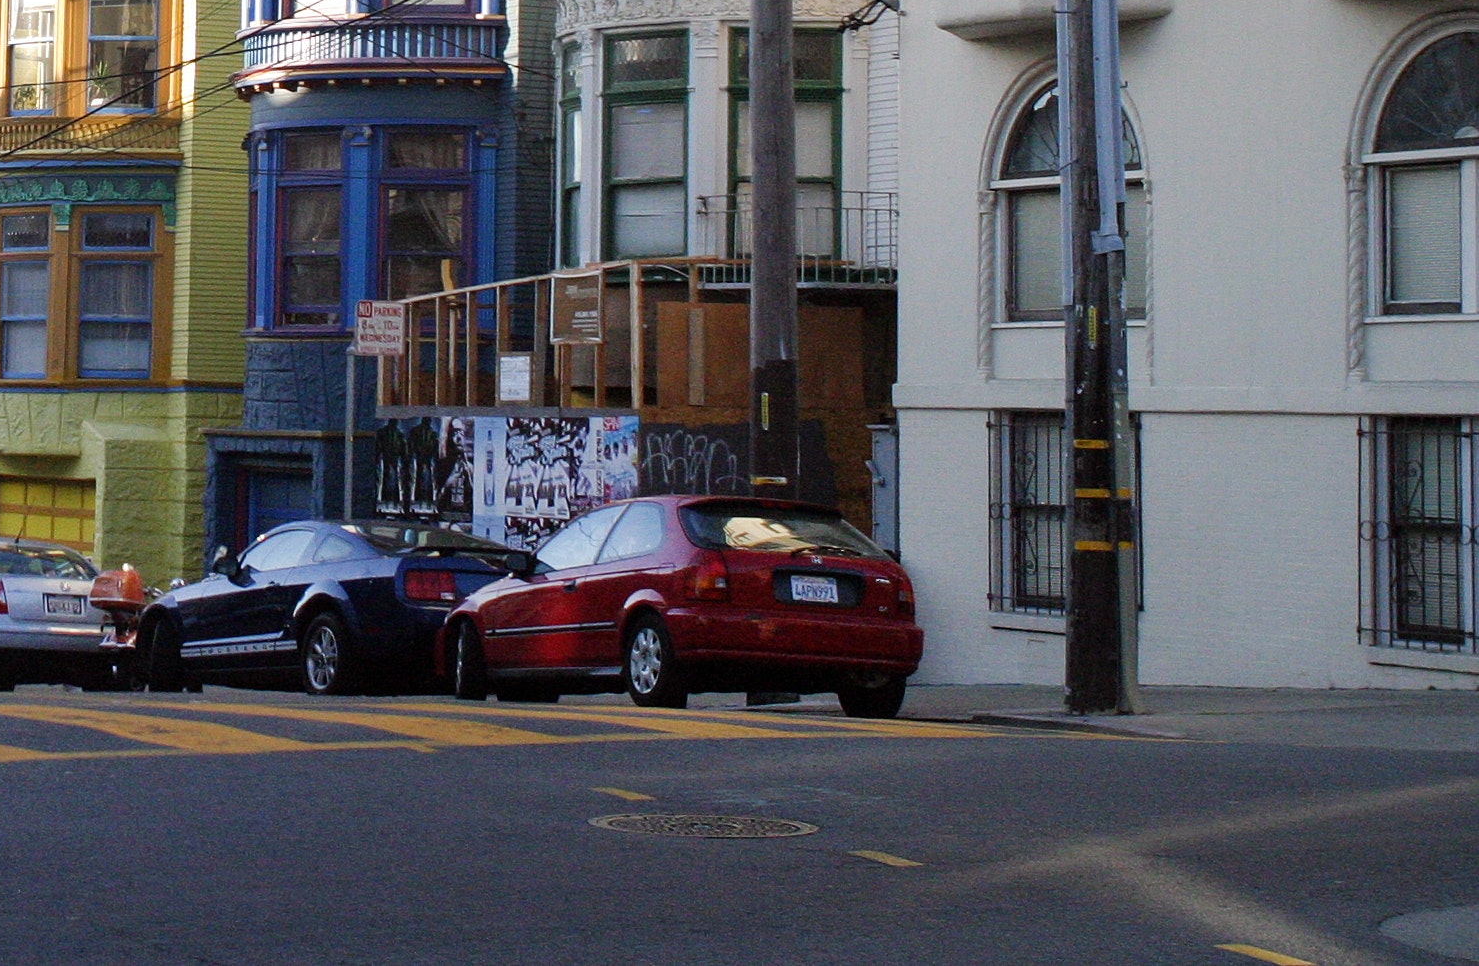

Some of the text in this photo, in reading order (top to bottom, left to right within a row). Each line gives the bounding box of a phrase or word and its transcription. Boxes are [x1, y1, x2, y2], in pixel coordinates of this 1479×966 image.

[359, 302, 402, 317] NO PARKING
[360, 334, 400, 343] WEDNESDAY
